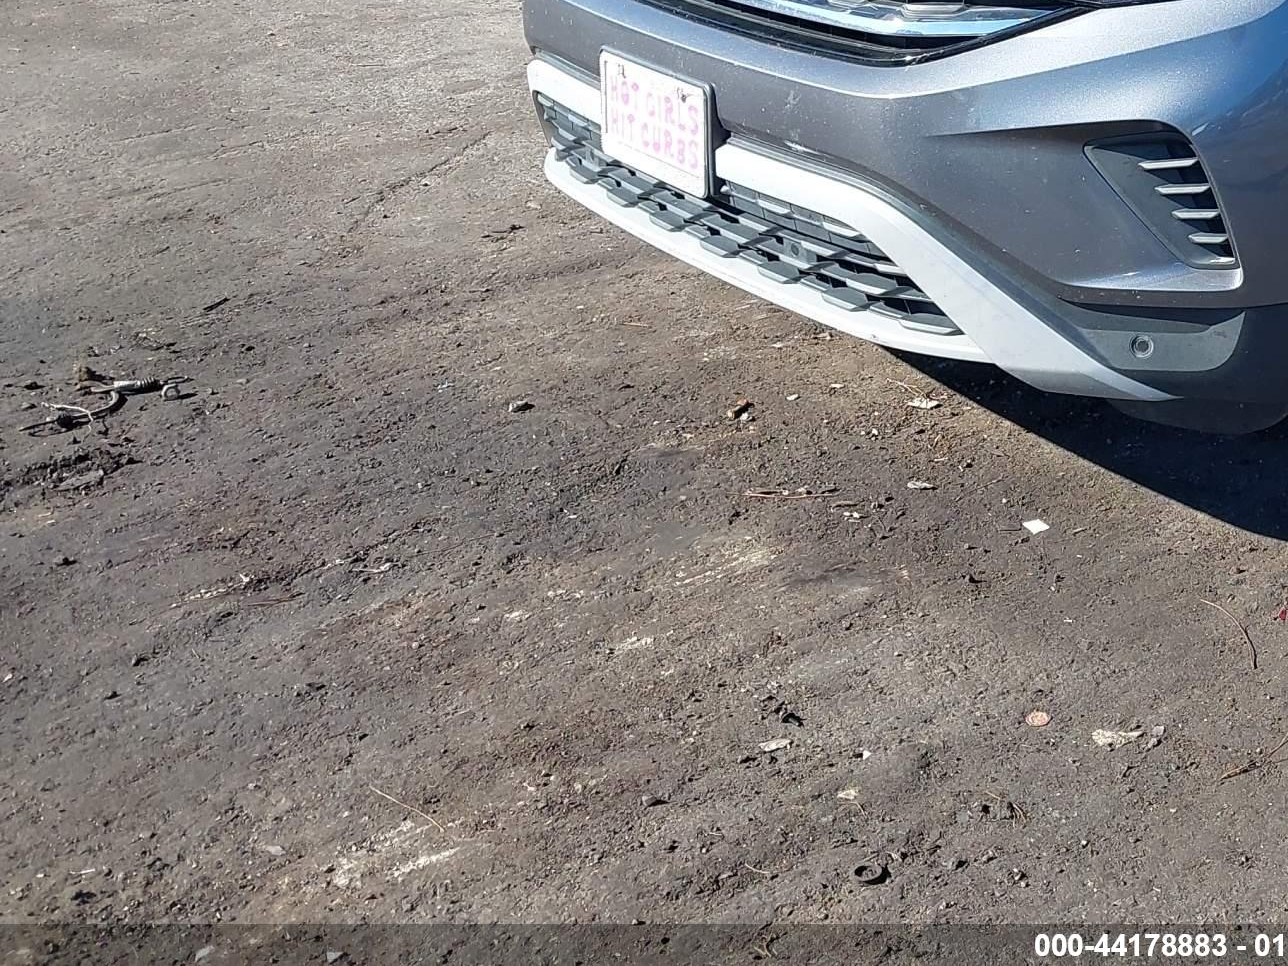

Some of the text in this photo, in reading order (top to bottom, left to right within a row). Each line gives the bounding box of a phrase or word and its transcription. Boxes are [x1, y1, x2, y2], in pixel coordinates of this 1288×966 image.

[610, 75, 699, 136] HOT GIRLS
[610, 107, 699, 170] HIT CURBS
